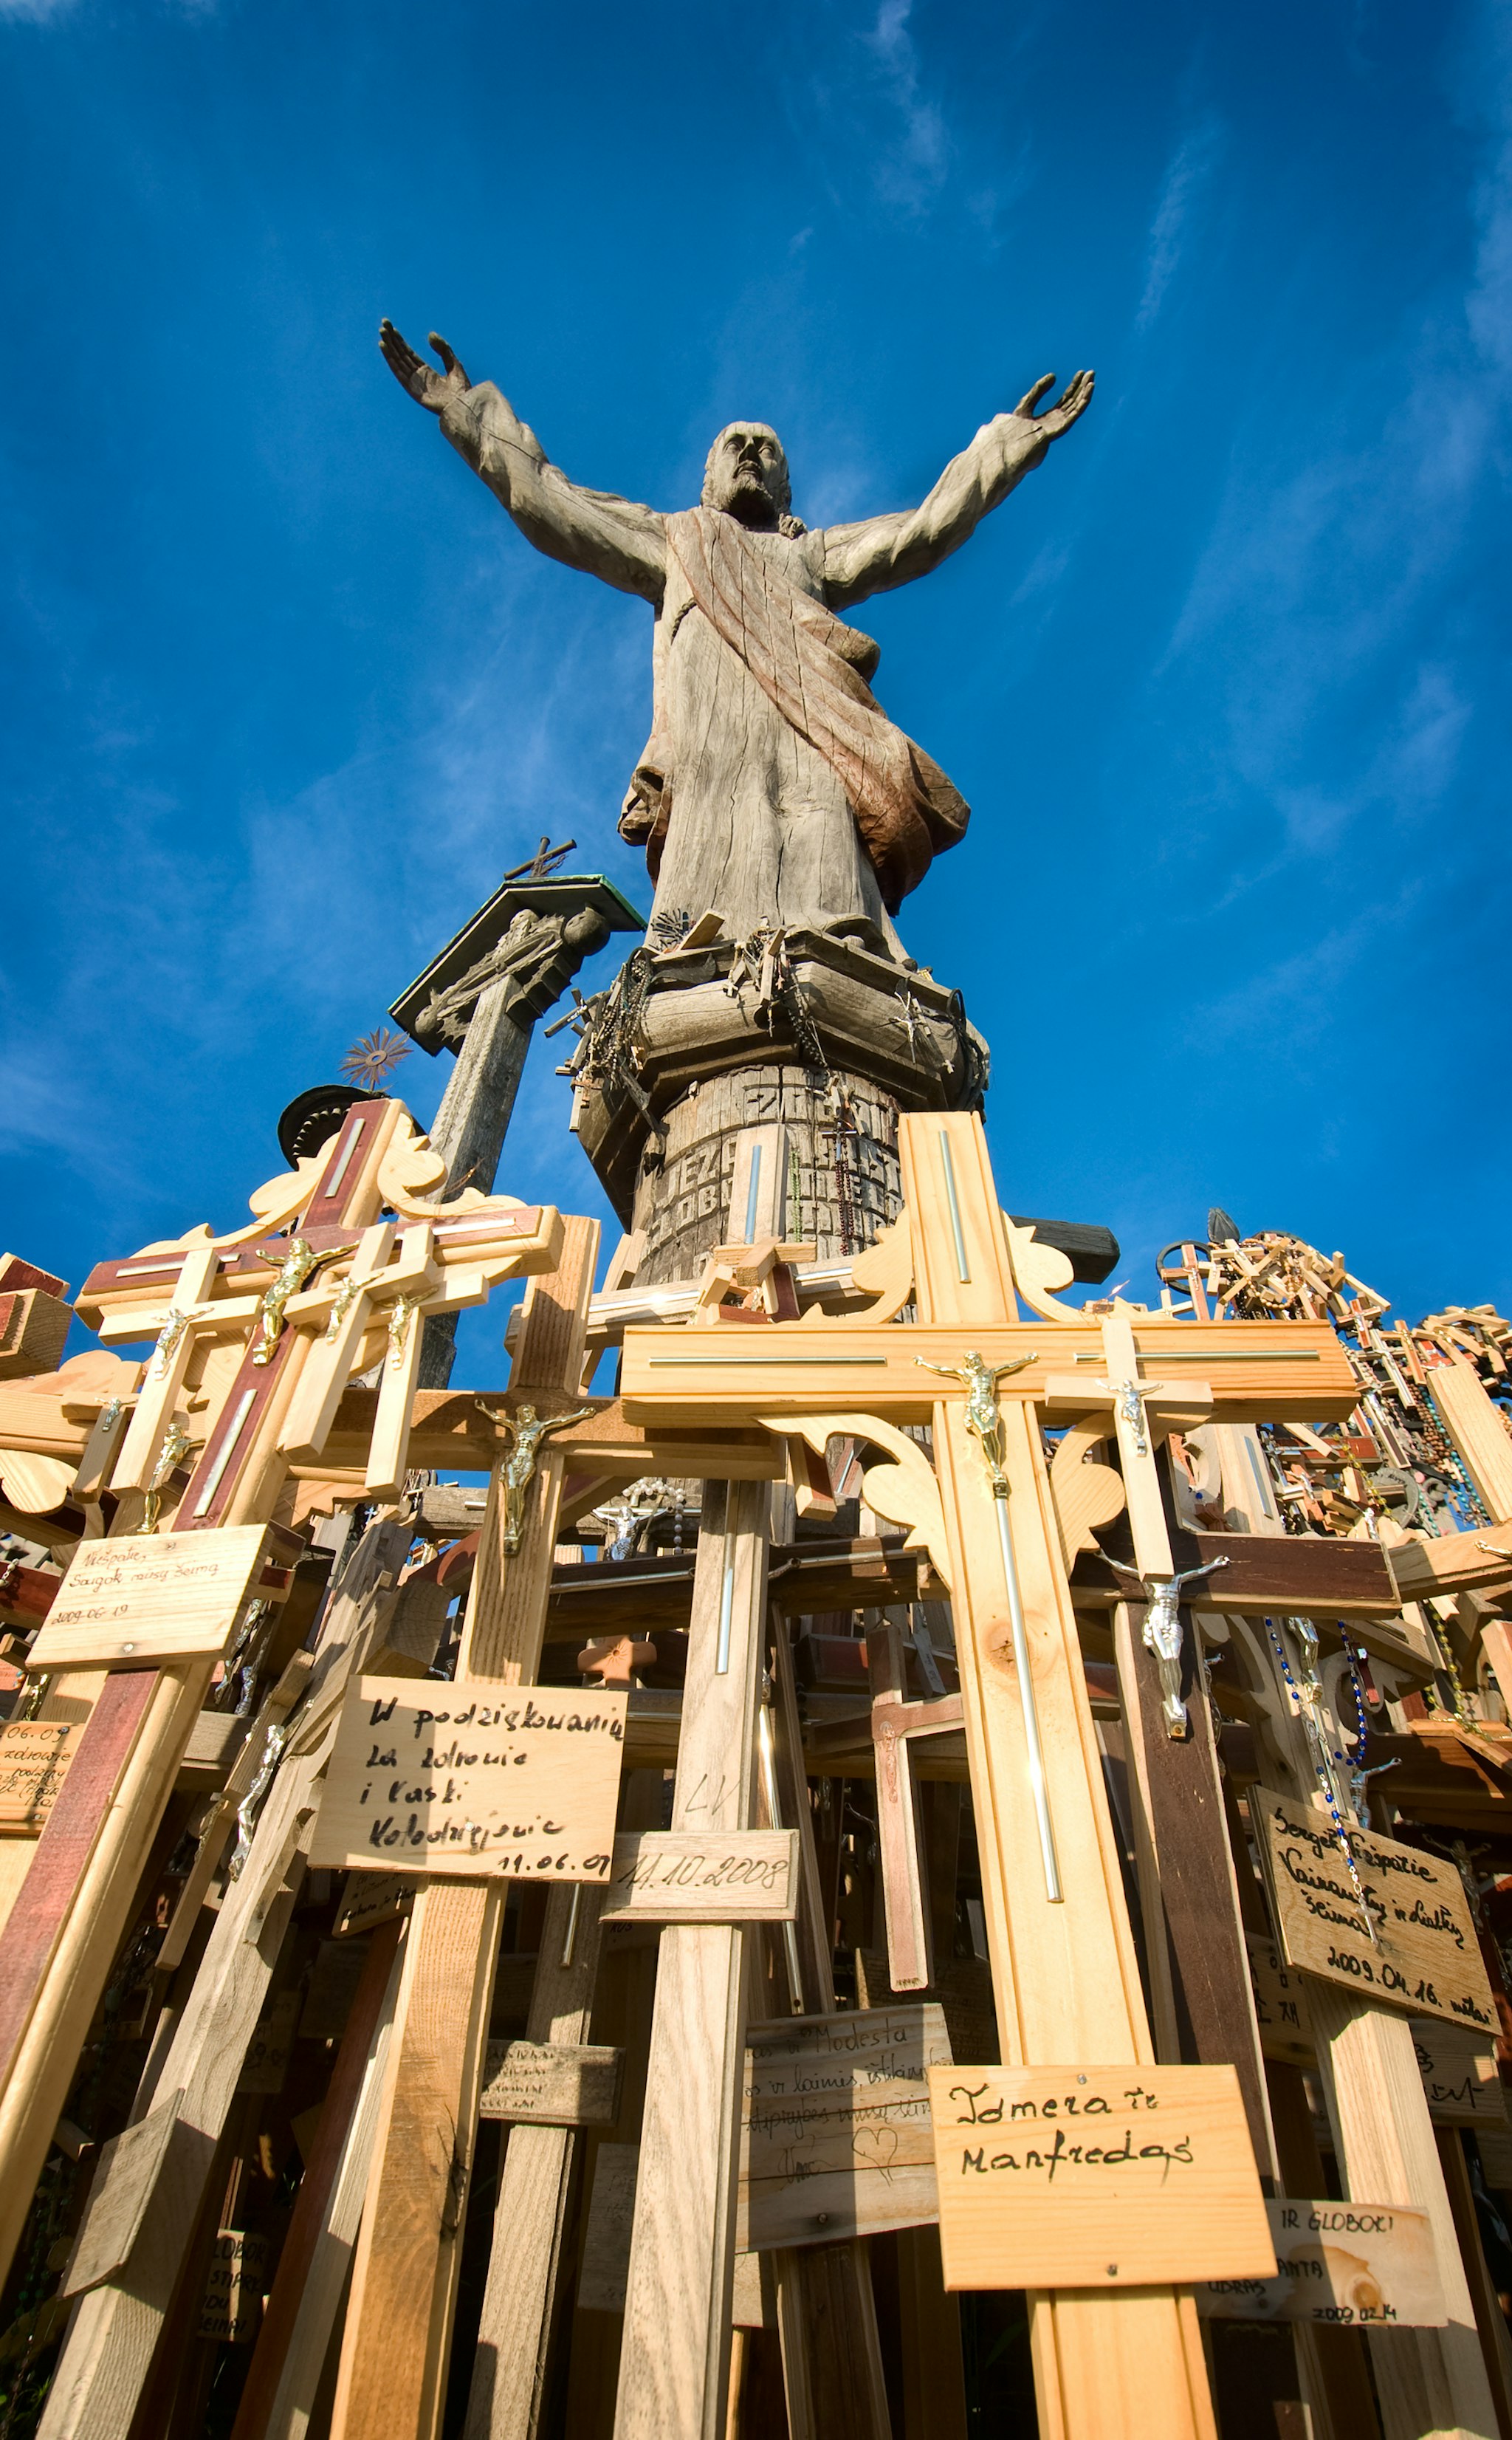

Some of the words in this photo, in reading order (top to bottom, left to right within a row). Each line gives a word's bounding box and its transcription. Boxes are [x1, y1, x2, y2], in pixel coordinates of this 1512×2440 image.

[360, 1782, 372, 1805] i
[815, 2018, 907, 2054] Modesta
[1282, 2209, 1300, 2229] IR
